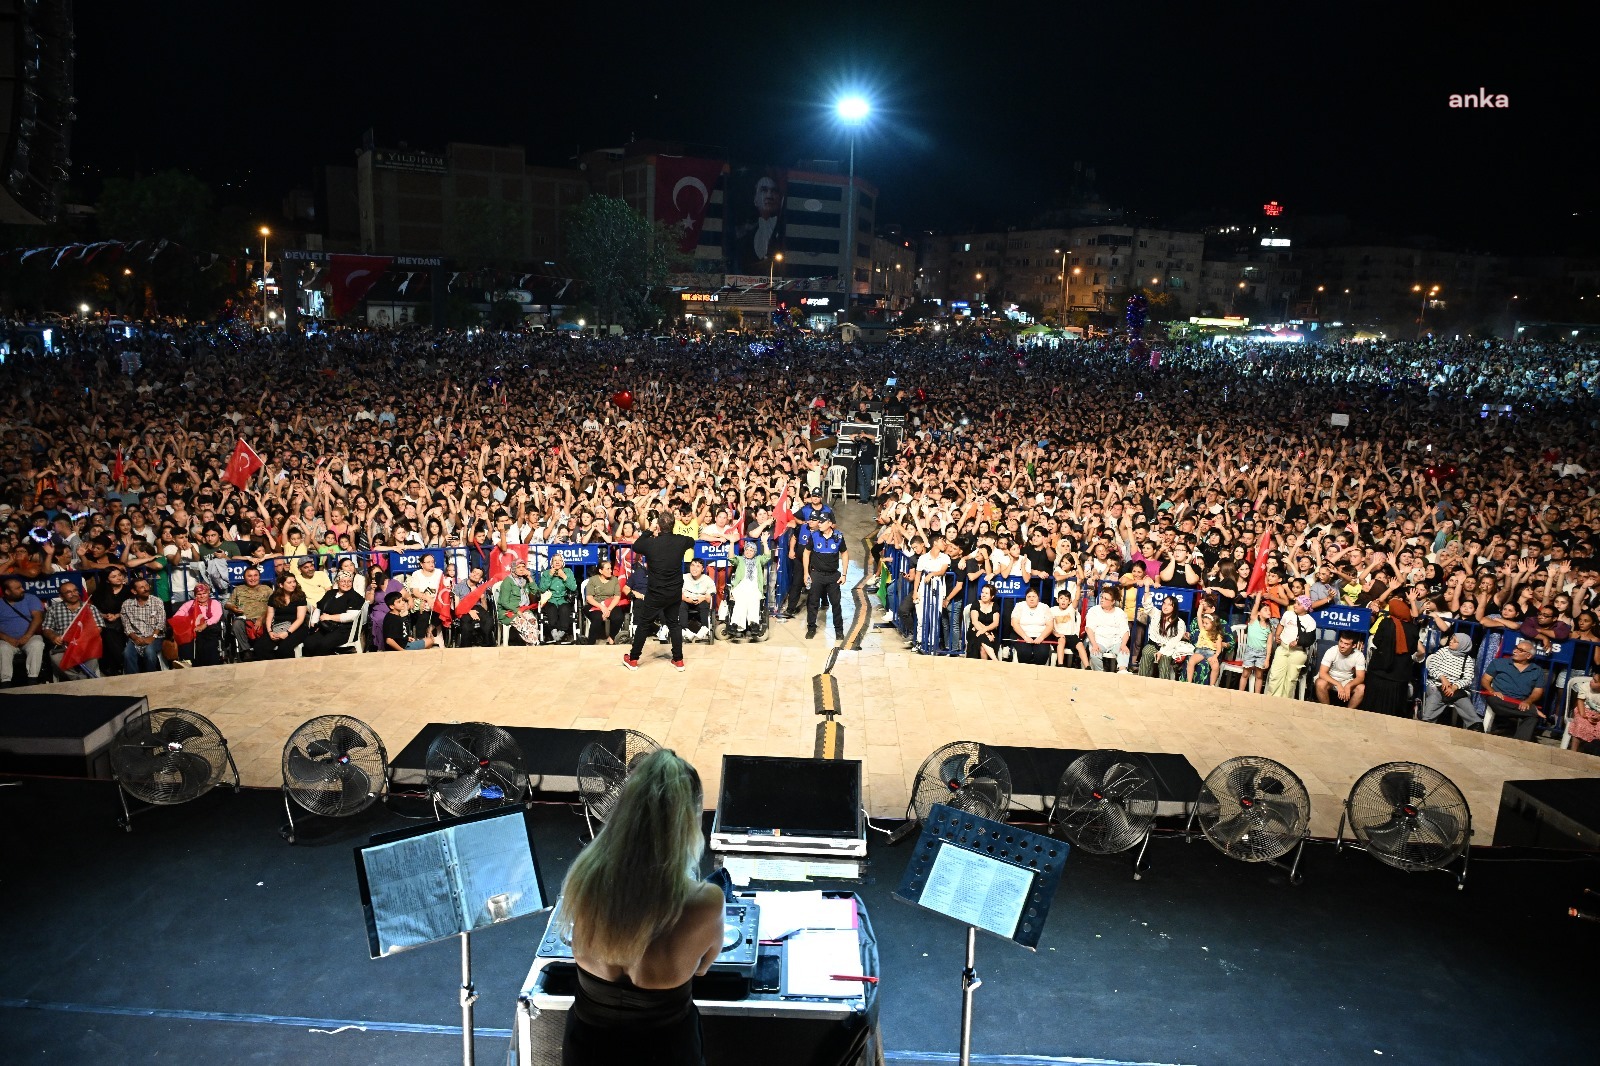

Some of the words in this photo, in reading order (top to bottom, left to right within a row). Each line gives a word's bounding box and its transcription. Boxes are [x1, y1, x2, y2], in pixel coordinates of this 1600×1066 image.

[388, 152, 444, 165] YILDIRIM
[285, 252, 323, 261] DEVLET
[1320, 610, 1360, 623] POLİS
